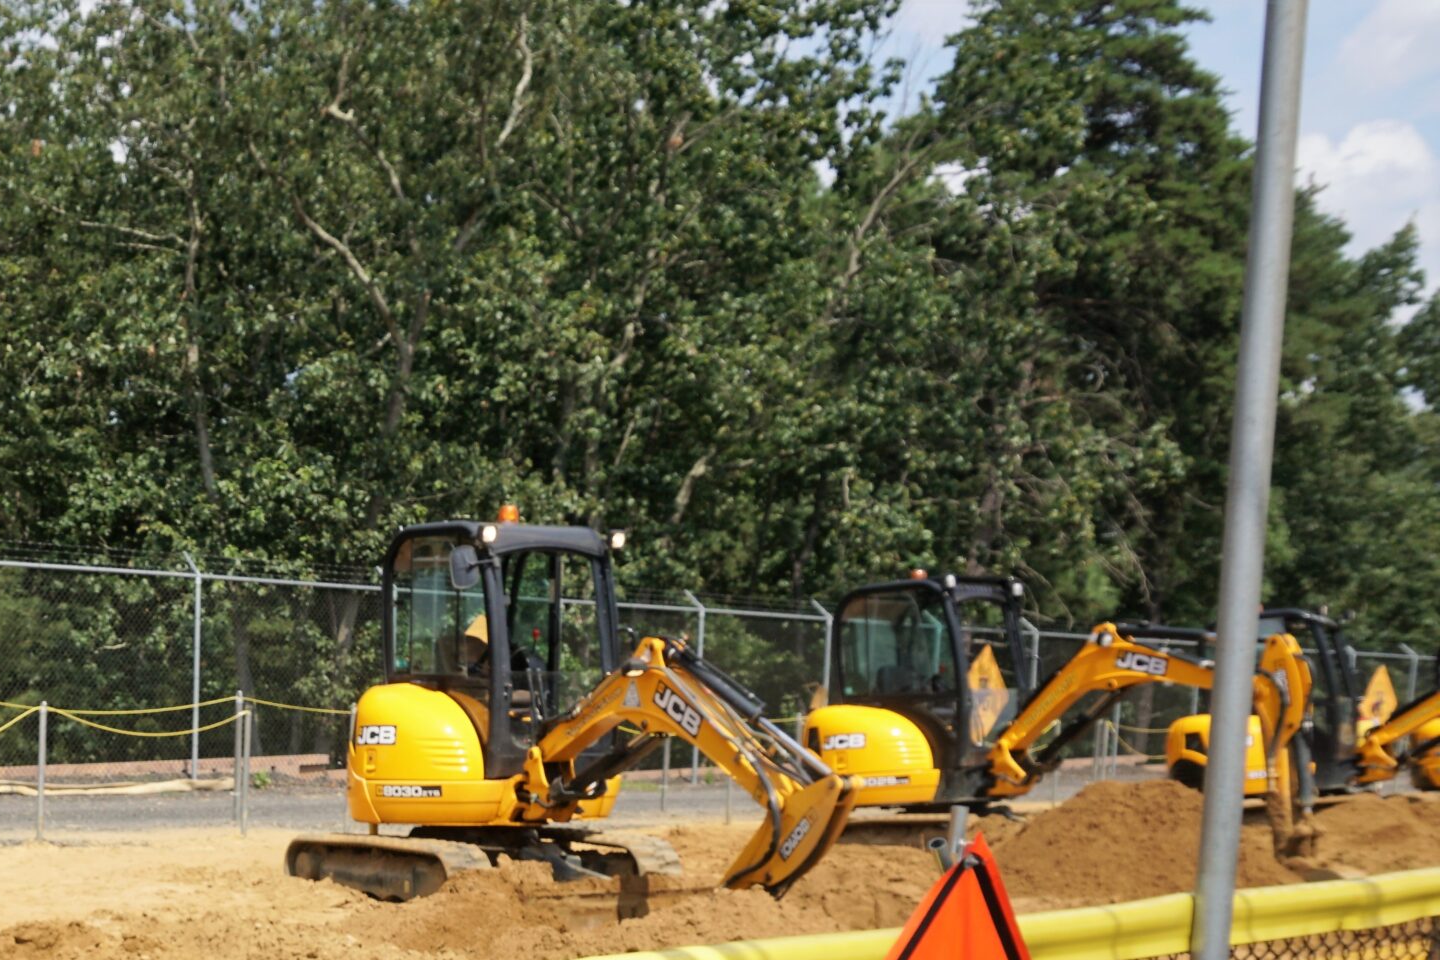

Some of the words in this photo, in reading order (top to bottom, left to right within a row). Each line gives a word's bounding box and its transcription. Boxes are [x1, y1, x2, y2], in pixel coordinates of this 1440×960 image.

[1116, 652, 1168, 675] JCB
[654, 688, 703, 737] JCB
[358, 725, 396, 745] JCB
[823, 733, 865, 750] JCB
